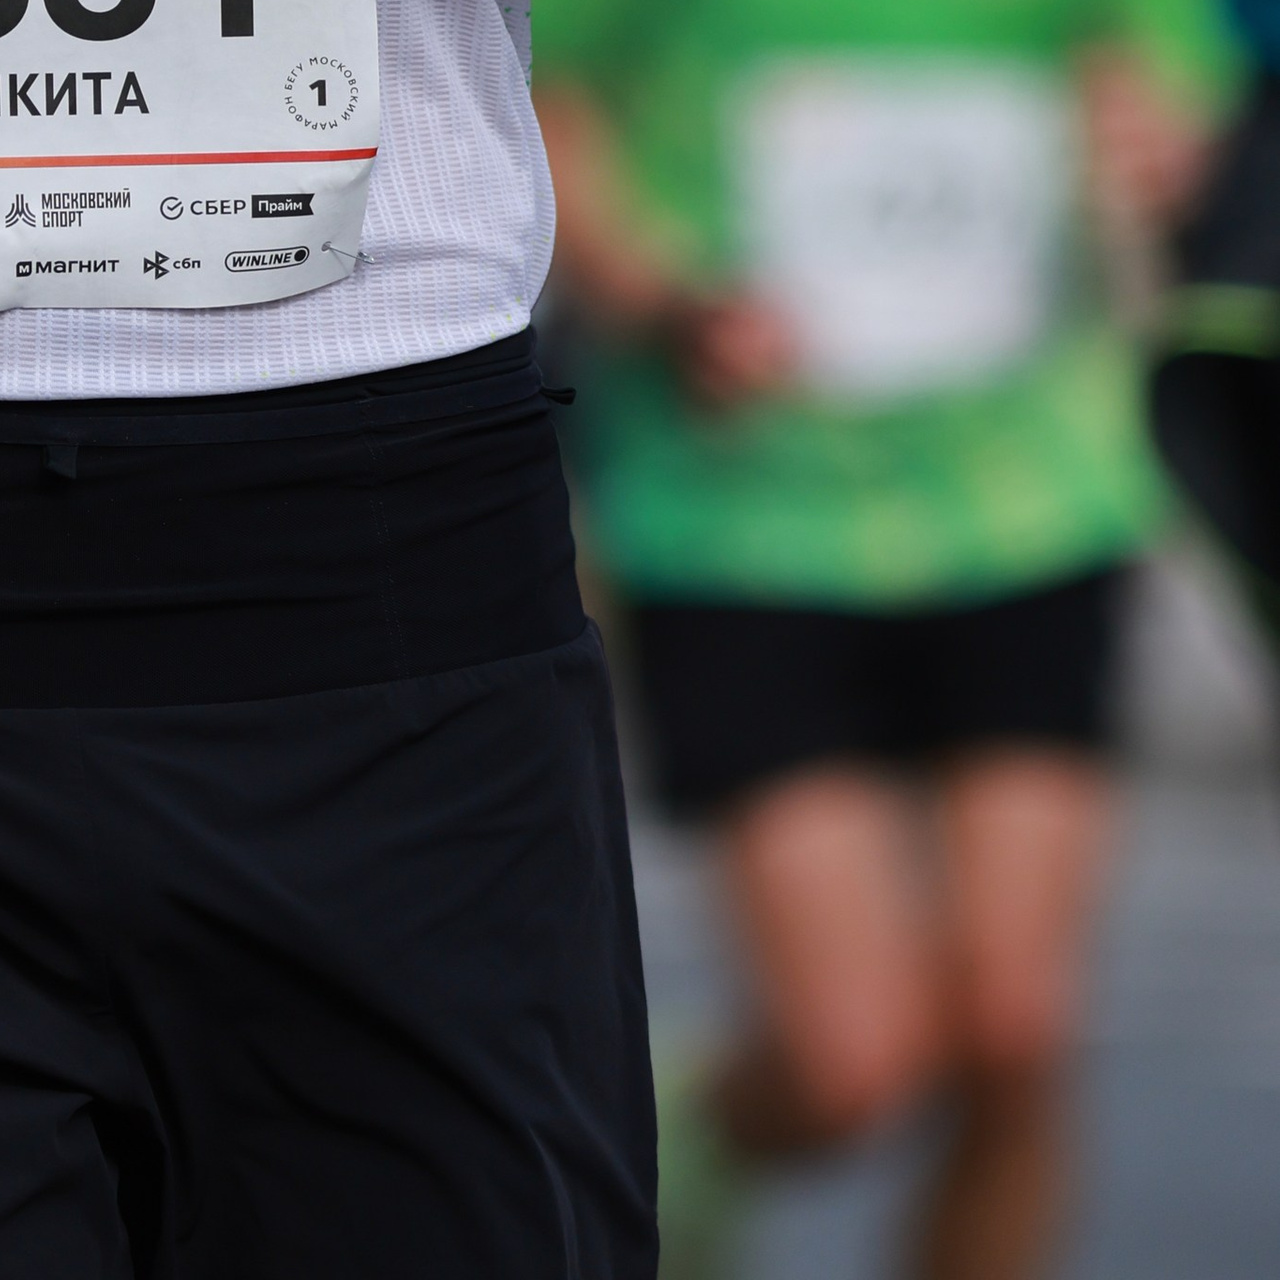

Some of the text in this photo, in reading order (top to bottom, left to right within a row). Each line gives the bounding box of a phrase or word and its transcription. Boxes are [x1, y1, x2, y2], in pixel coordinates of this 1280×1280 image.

[309, 79, 327, 106] 1
[41, 188, 131, 209] МОСКОВСКИЙ
[190, 198, 303, 216] СБЕР Прайм
[42, 211, 84, 228] СПОРТ
[172, 257, 201, 270] сбп
[232, 251, 293, 268] WINLINE
